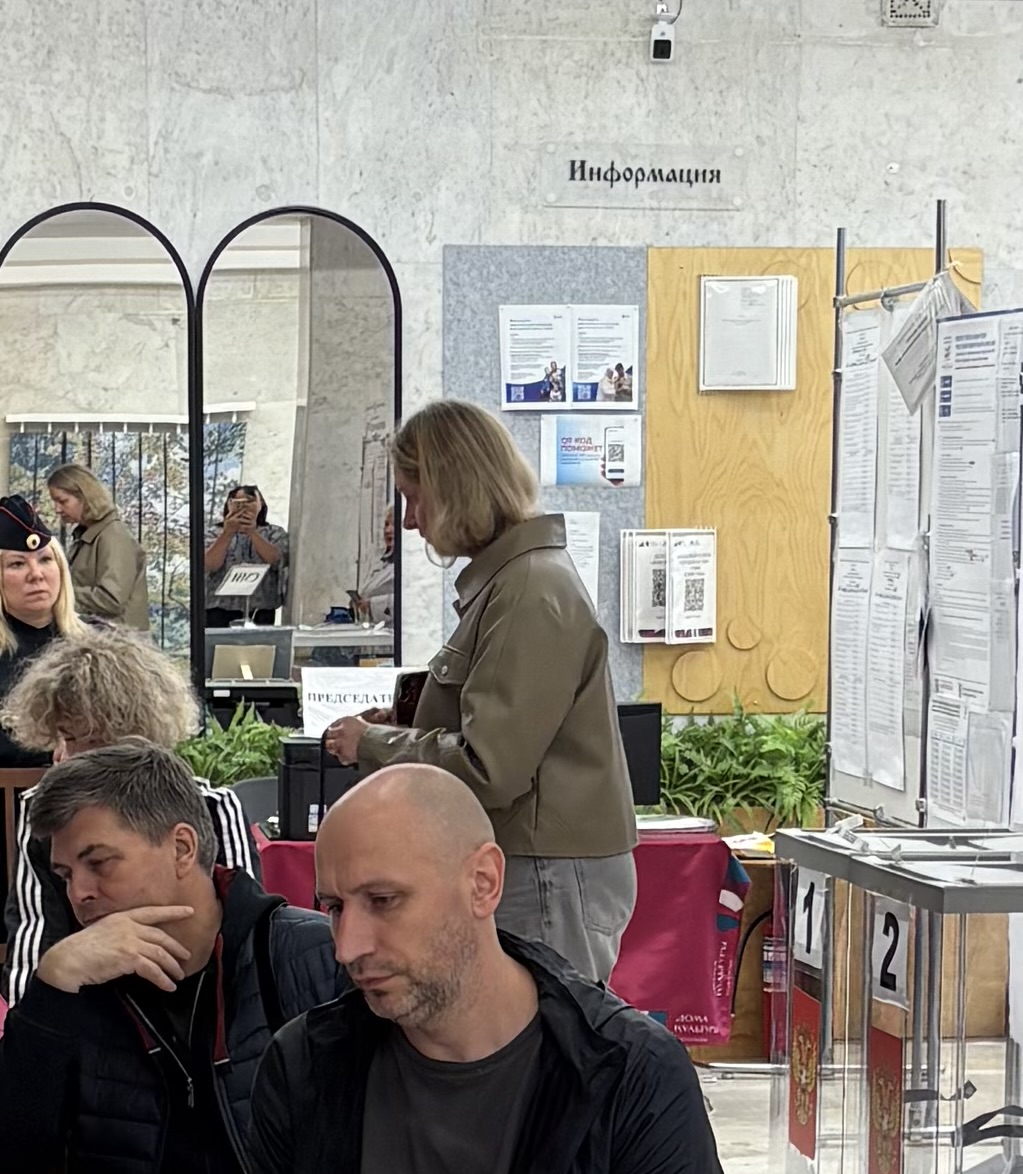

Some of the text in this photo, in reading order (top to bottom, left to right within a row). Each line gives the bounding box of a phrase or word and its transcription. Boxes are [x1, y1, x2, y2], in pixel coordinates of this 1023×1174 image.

[568, 159, 721, 189] Информация
[803, 881, 815, 955] 1
[879, 911, 900, 992] 2
